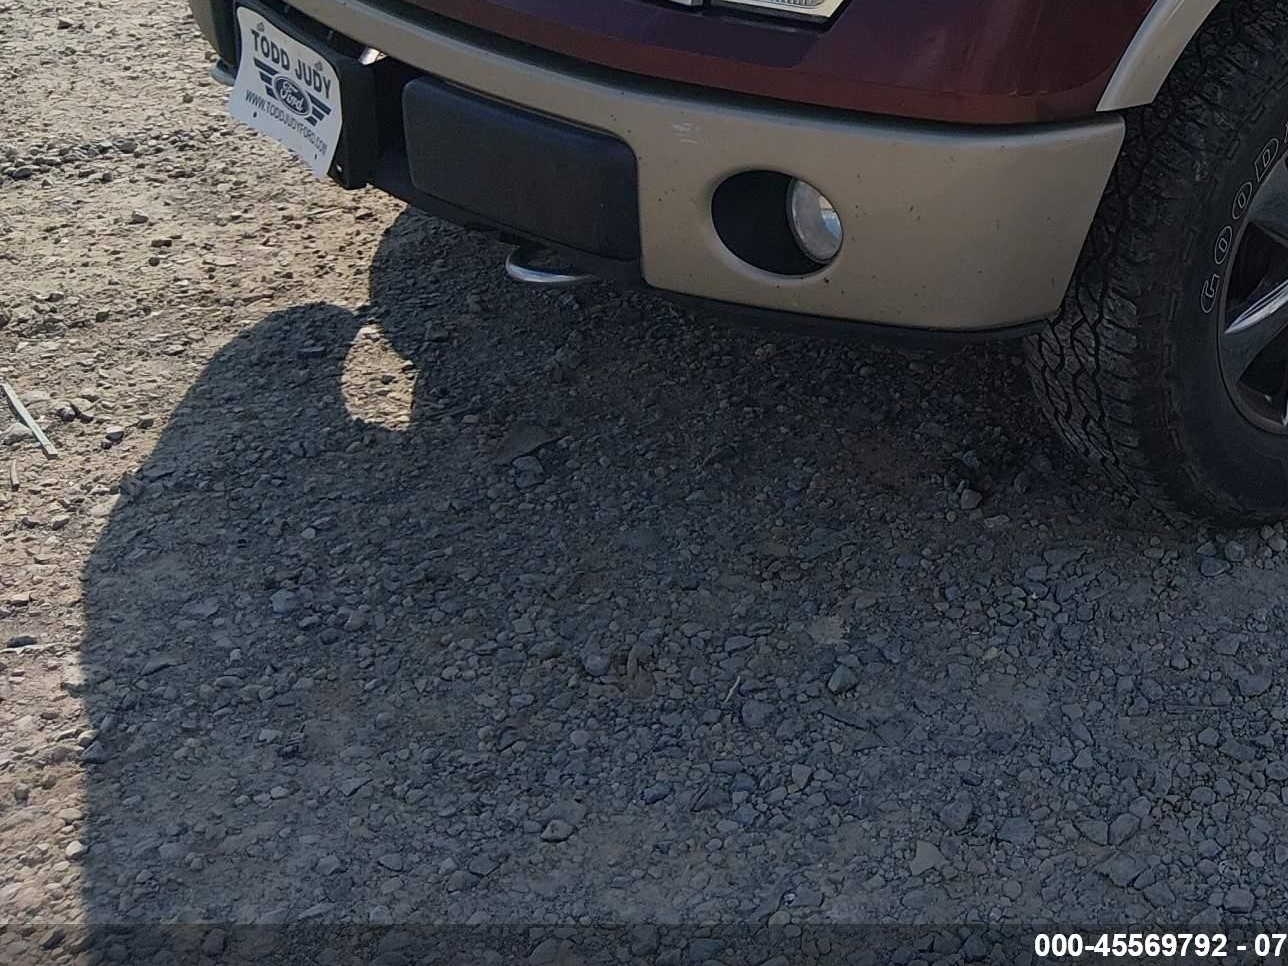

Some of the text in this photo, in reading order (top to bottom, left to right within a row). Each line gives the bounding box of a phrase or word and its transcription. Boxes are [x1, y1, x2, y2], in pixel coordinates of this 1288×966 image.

[251, 30, 332, 99] TODD JUDY
[279, 83, 305, 112] Ford
[245, 89, 328, 156] WWW.TODDJUDYFORD.COM
